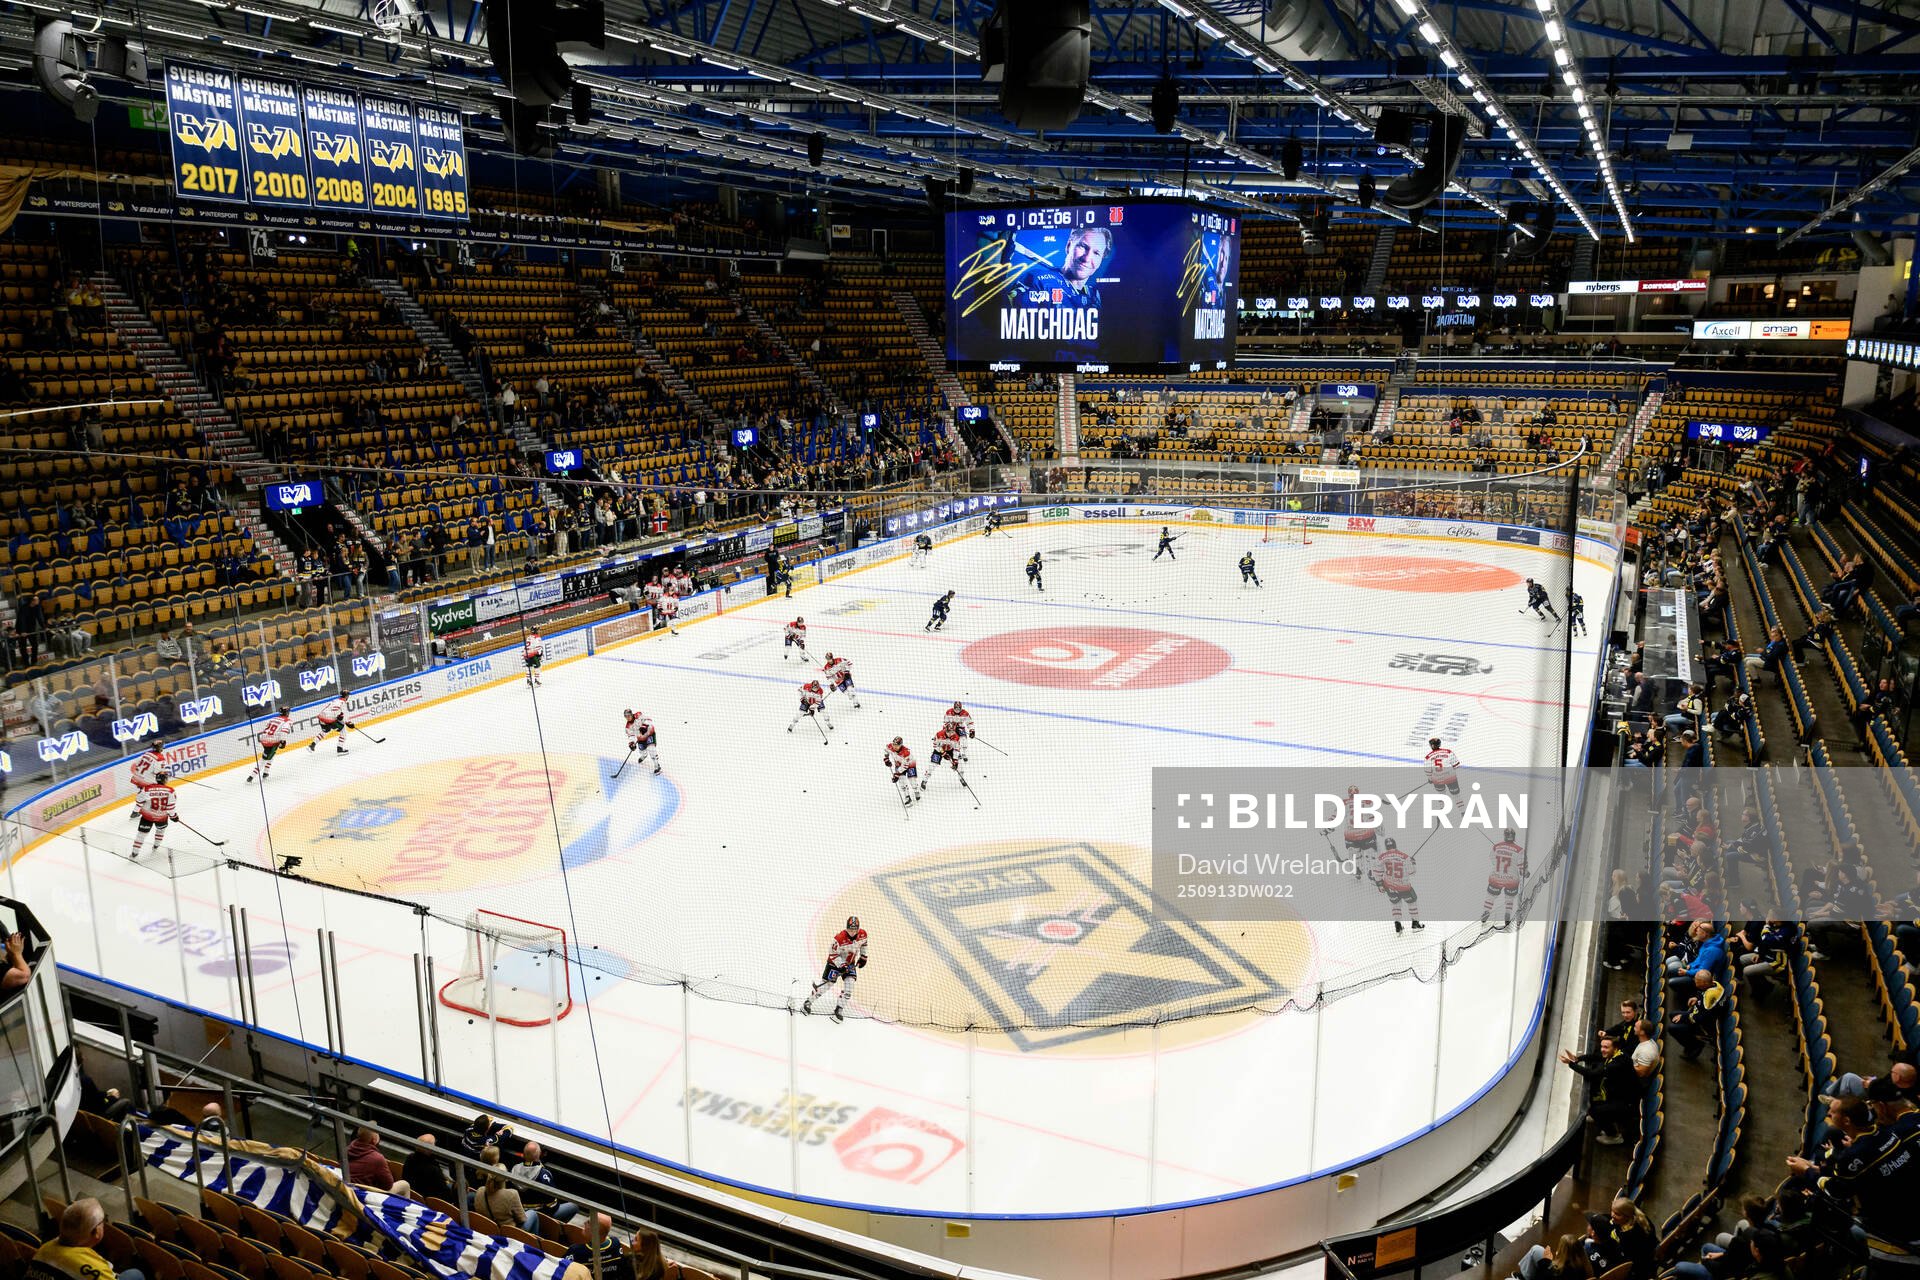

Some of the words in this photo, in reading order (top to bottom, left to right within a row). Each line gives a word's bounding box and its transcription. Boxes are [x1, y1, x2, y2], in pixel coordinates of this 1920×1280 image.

[170, 66, 231, 90] SVENSKA
[241, 78, 295, 98] SVENSKA
[171, 84, 233, 109] MÄSTARE
[243, 95, 297, 116] MÄSTARE
[306, 88, 355, 108] SVENSKA
[365, 98, 410, 117] SVENSKA
[307, 104, 356, 125] MÄSTARE
[366, 113, 411, 133] MÄSTARE
[418, 107, 459, 125] SVENSKA
[174, 112, 237, 153] HV71
[247, 122, 301, 160] HV71
[419, 122, 461, 141] MÄSTARE
[310, 131, 361, 167] HV71
[368, 139, 414, 174] HV71
[421, 146, 464, 180] HV71
[181, 163, 239, 194] 2017
[253, 170, 307, 199] 2010
[316, 177, 364, 204] 2008
[373, 182, 417, 209] 2004
[424, 188, 466, 214] 1995
[59, 201, 100, 209] INTERSPORT
[205, 211, 238, 219] INTERSPORT
[271, 216, 299, 224] BAUER
[1006, 213, 1016, 226] 0
[1028, 212, 1071, 225] 01:06
[1085, 211, 1095, 224] 0
[1586, 283, 1621, 292] nybergs
[1000, 308, 1099, 340] MATCHDAG
[1194, 308, 1226, 340] MATCHDAG
[1712, 326, 1740, 336] Axcell
[990, 361, 1021, 372] nybergs
[1076, 363, 1109, 373] nybergs
[279, 484, 312, 505] HV71
[1084, 507, 1126, 518] essell
[1347, 517, 1376, 528] SEW
[828, 556, 856, 574] nybergs
[431, 606, 473, 631] Sydved
[299, 666, 336, 692] HV71
[457, 661, 491, 680] STENA
[242, 680, 282, 707] HV71
[180, 695, 223, 724] HV71
[112, 712, 159, 742] HV71
[38, 731, 89, 762] HV71
[165, 742, 207, 764] NTER
[1434, 759, 1443, 772] 5
[1495, 856, 1512, 873] 17
[678, 1087, 838, 1146] SVENSKA
[1347, 1255, 1357, 1266] N
